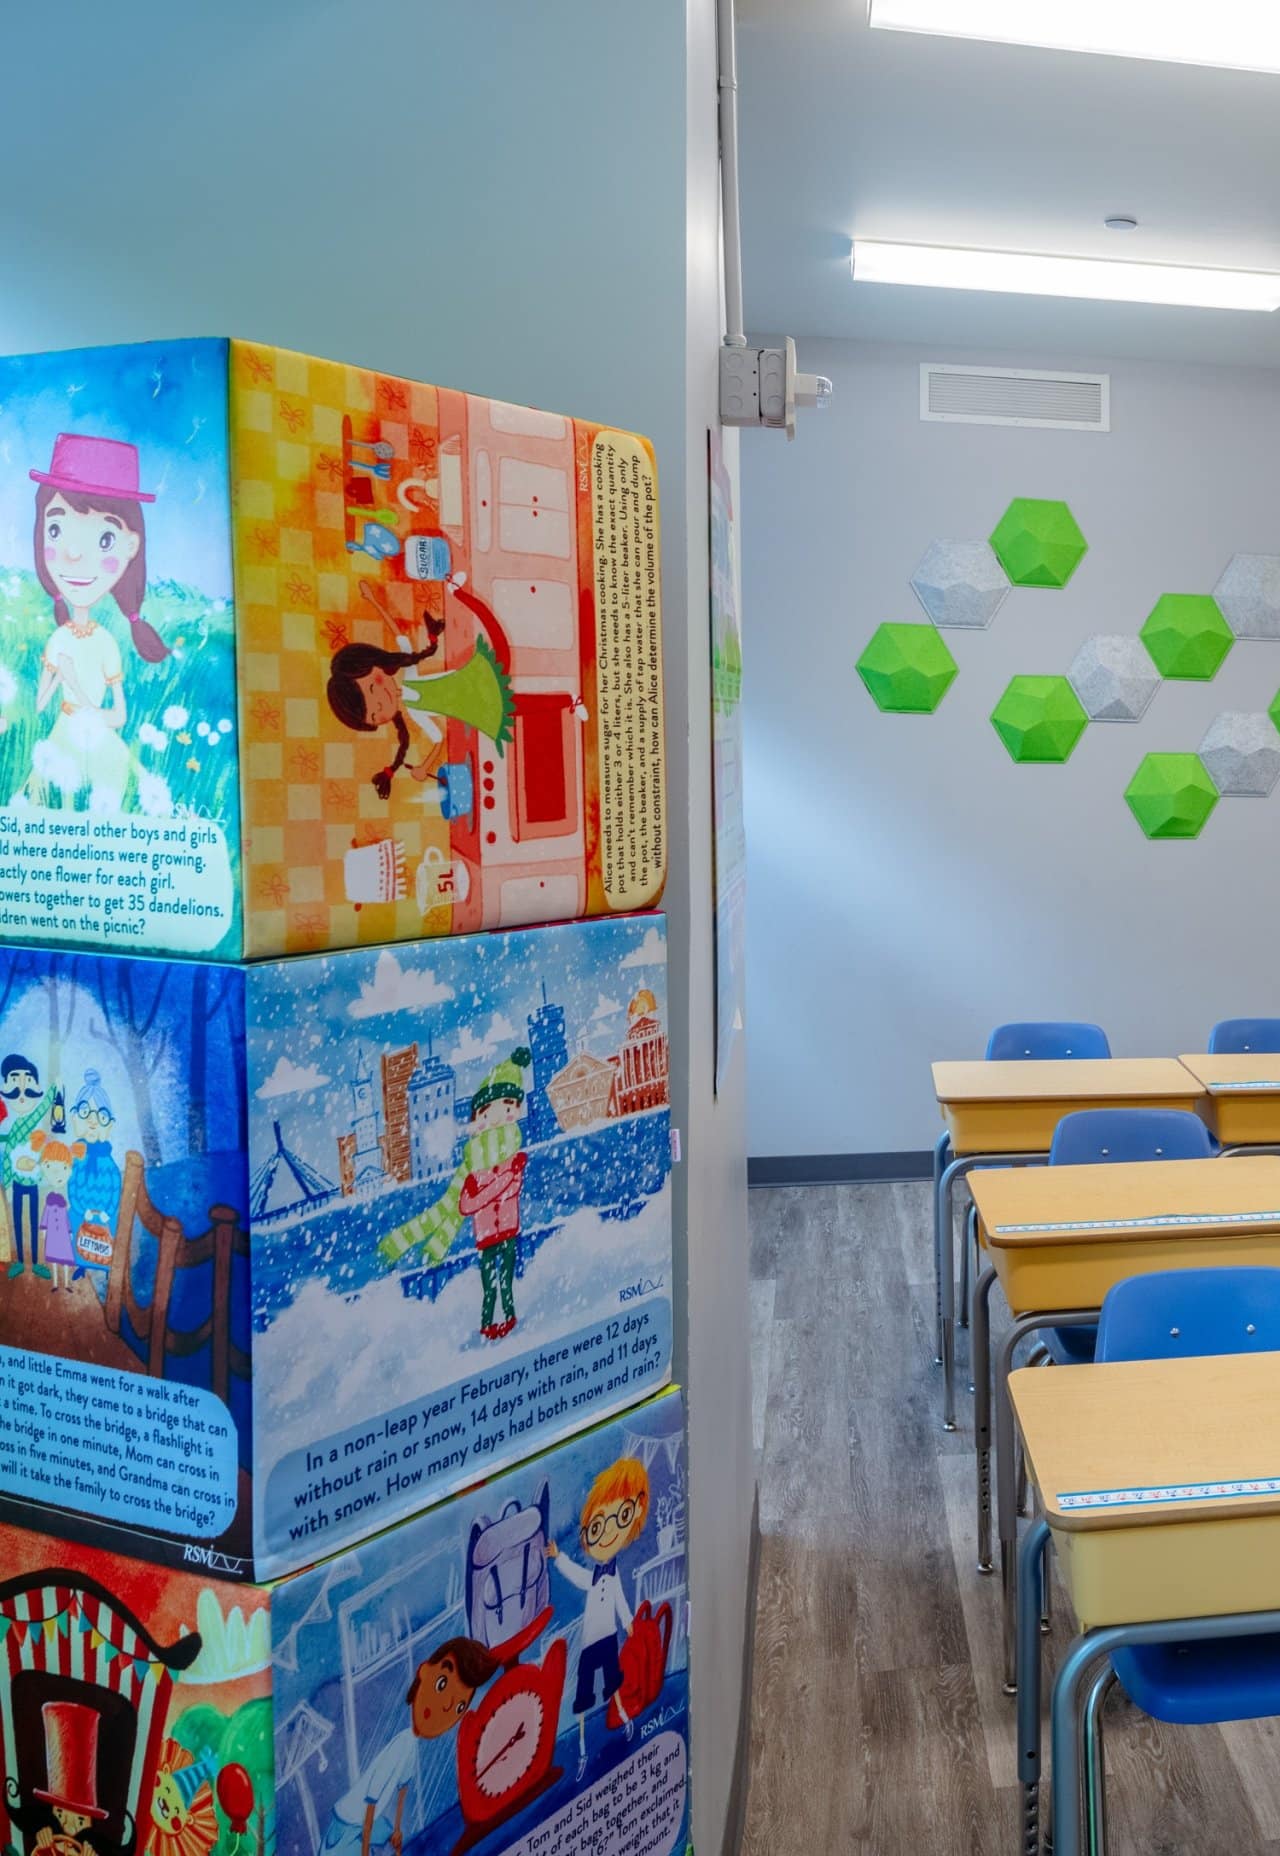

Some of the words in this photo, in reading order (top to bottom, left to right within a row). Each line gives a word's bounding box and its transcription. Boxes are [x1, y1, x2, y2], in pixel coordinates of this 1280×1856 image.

[593, 444, 604, 490] cooking
[642, 475, 656, 501] pot?
[643, 504, 653, 523] the
[596, 528, 604, 550] She
[643, 527, 653, 540] of
[597, 555, 608, 605] cooking.
[644, 543, 655, 585] volume
[646, 588, 655, 607] the
[599, 608, 608, 670] Christmas
[647, 611, 657, 671] determine
[600, 674, 608, 693] her
[648, 674, 658, 704] Alice
[600, 697, 609, 714] for
[651, 708, 659, 728] can
[603, 720, 612, 750] sugar
[649, 731, 659, 754] how
[652, 758, 661, 821] constraint,
[605, 808, 611, 820] to
[0, 816, 21, 836] Sid,
[25, 819, 45, 834] and
[49, 820, 89, 836] several
[93, 822, 127, 838] other
[131, 823, 159, 845] boys
[164, 826, 186, 842] and
[190, 827, 217, 849] girls
[603, 824, 612, 859] needs
[651, 824, 661, 868] without
[13, 841, 47, 858] where
[51, 843, 114, 861] dandelions
[119, 852, 148, 864] were
[152, 850, 206, 874] growing.
[31, 870, 52, 881] one
[55, 865, 92, 883] flower
[96, 868, 113, 885] for
[117, 871, 146, 887] each
[150, 873, 175, 895] girl.
[438, 869, 454, 893] 5L
[604, 863, 613, 893] Alice
[34, 890, 85, 911] together
[88, 895, 101, 908] to
[104, 897, 124, 915] get
[128, 894, 145, 911] 35
[149, 896, 224, 917] dandelions.
[31, 916, 59, 928] went
[62, 918, 76, 929] on
[80, 915, 99, 931] the
[103, 917, 145, 937] picnic?
[619, 1279, 644, 1303] RSM
[8, 1355, 25, 1370] and
[28, 1357, 52, 1375] little
[55, 1362, 87, 1383] Emma
[90, 1376, 116, 1389] went
[119, 1376, 135, 1392] for
[137, 1385, 143, 1395] a
[146, 1385, 170, 1401] walk
[173, 1389, 200, 1407] after
[307, 1452, 323, 1472] In
[329, 1449, 338, 1463] a
[344, 1415, 418, 1456] non-leap
[422, 1397, 456, 1428] year
[461, 1367, 529, 1404] February,
[533, 1349, 569, 1372] there
[573, 1334, 603, 1355] were
[606, 1321, 619, 1340] 12
[623, 1314, 649, 1333] days
[8, 1374, 15, 1389] it
[18, 1381, 34, 1396] got
[37, 1381, 62, 1402] dark,
[65, 1388, 89, 1410] they
[91, 1397, 119, 1412] came
[122, 1402, 134, 1415] to
[137, 1408, 142, 1418] a
[145, 1405, 179, 1430] bridge
[182, 1414, 205, 1432] that
[208, 1425, 228, 1437] can
[294, 1466, 362, 1508] without
[367, 1450, 397, 1476] rain
[403, 1441, 419, 1459] or
[424, 1422, 466, 1449] snow,
[471, 1405, 488, 1427] 14
[492, 1394, 523, 1417] days
[527, 1376, 556, 1401] with
[560, 1365, 588, 1387] rain,
[592, 1348, 614, 1372] and
[618, 1342, 627, 1360] 11
[632, 1334, 657, 1354] days
[3, 1399, 9, 1409] a
[12, 1397, 37, 1416] time.
[40, 1402, 52, 1419] To
[55, 1411, 81, 1426] cross
[84, 1414, 101, 1430] the
[104, 1417, 140, 1443] bridge,
[143, 1432, 149, 1442] a
[153, 1428, 202, 1457] flashlight
[205, 1442, 214, 1457] is
[289, 1509, 328, 1541] with
[334, 1492, 380, 1522] snow.
[387, 1469, 423, 1496] How
[428, 1446, 468, 1476] many
[473, 1430, 505, 1454] days
[509, 1410, 533, 1437] had
[538, 1396, 568, 1423] both
[572, 1384, 603, 1407] snow
[607, 1366, 629, 1391] and
[633, 1351, 661, 1379] rain?
[0, 1460, 17, 1475] will
[20, 1463, 28, 1478] it
[30, 1468, 51, 1484] take
[54, 1473, 72, 1489] the
[75, 1476, 107, 1502] family
[109, 1488, 120, 1501] to
[123, 1494, 151, 1509] cross
[154, 1498, 172, 1515] the
[175, 1502, 215, 1528] bridge?
[184, 1543, 215, 1568] RSM
[527, 1831, 550, 1853] Tom
[554, 1808, 572, 1834] and
[576, 1793, 592, 1817] Sid
[595, 1760, 635, 1801] weighed
[638, 1744, 660, 1766] their
[551, 1834, 563, 1855] of
[565, 1817, 589, 1844] each
[592, 1803, 610, 1823] bag
[613, 1793, 623, 1806] to
[626, 1781, 638, 1796] be
[640, 1769, 647, 1785] 3
[650, 1763, 662, 1778] kg
[663, 1743, 680, 1767] and
[581, 1827, 603, 1851] bags
[652, 1769, 668, 1794] and
[618, 1824, 649, 1856] weight
[652, 1807, 670, 1829] that
[672, 1799, 680, 1811] it
